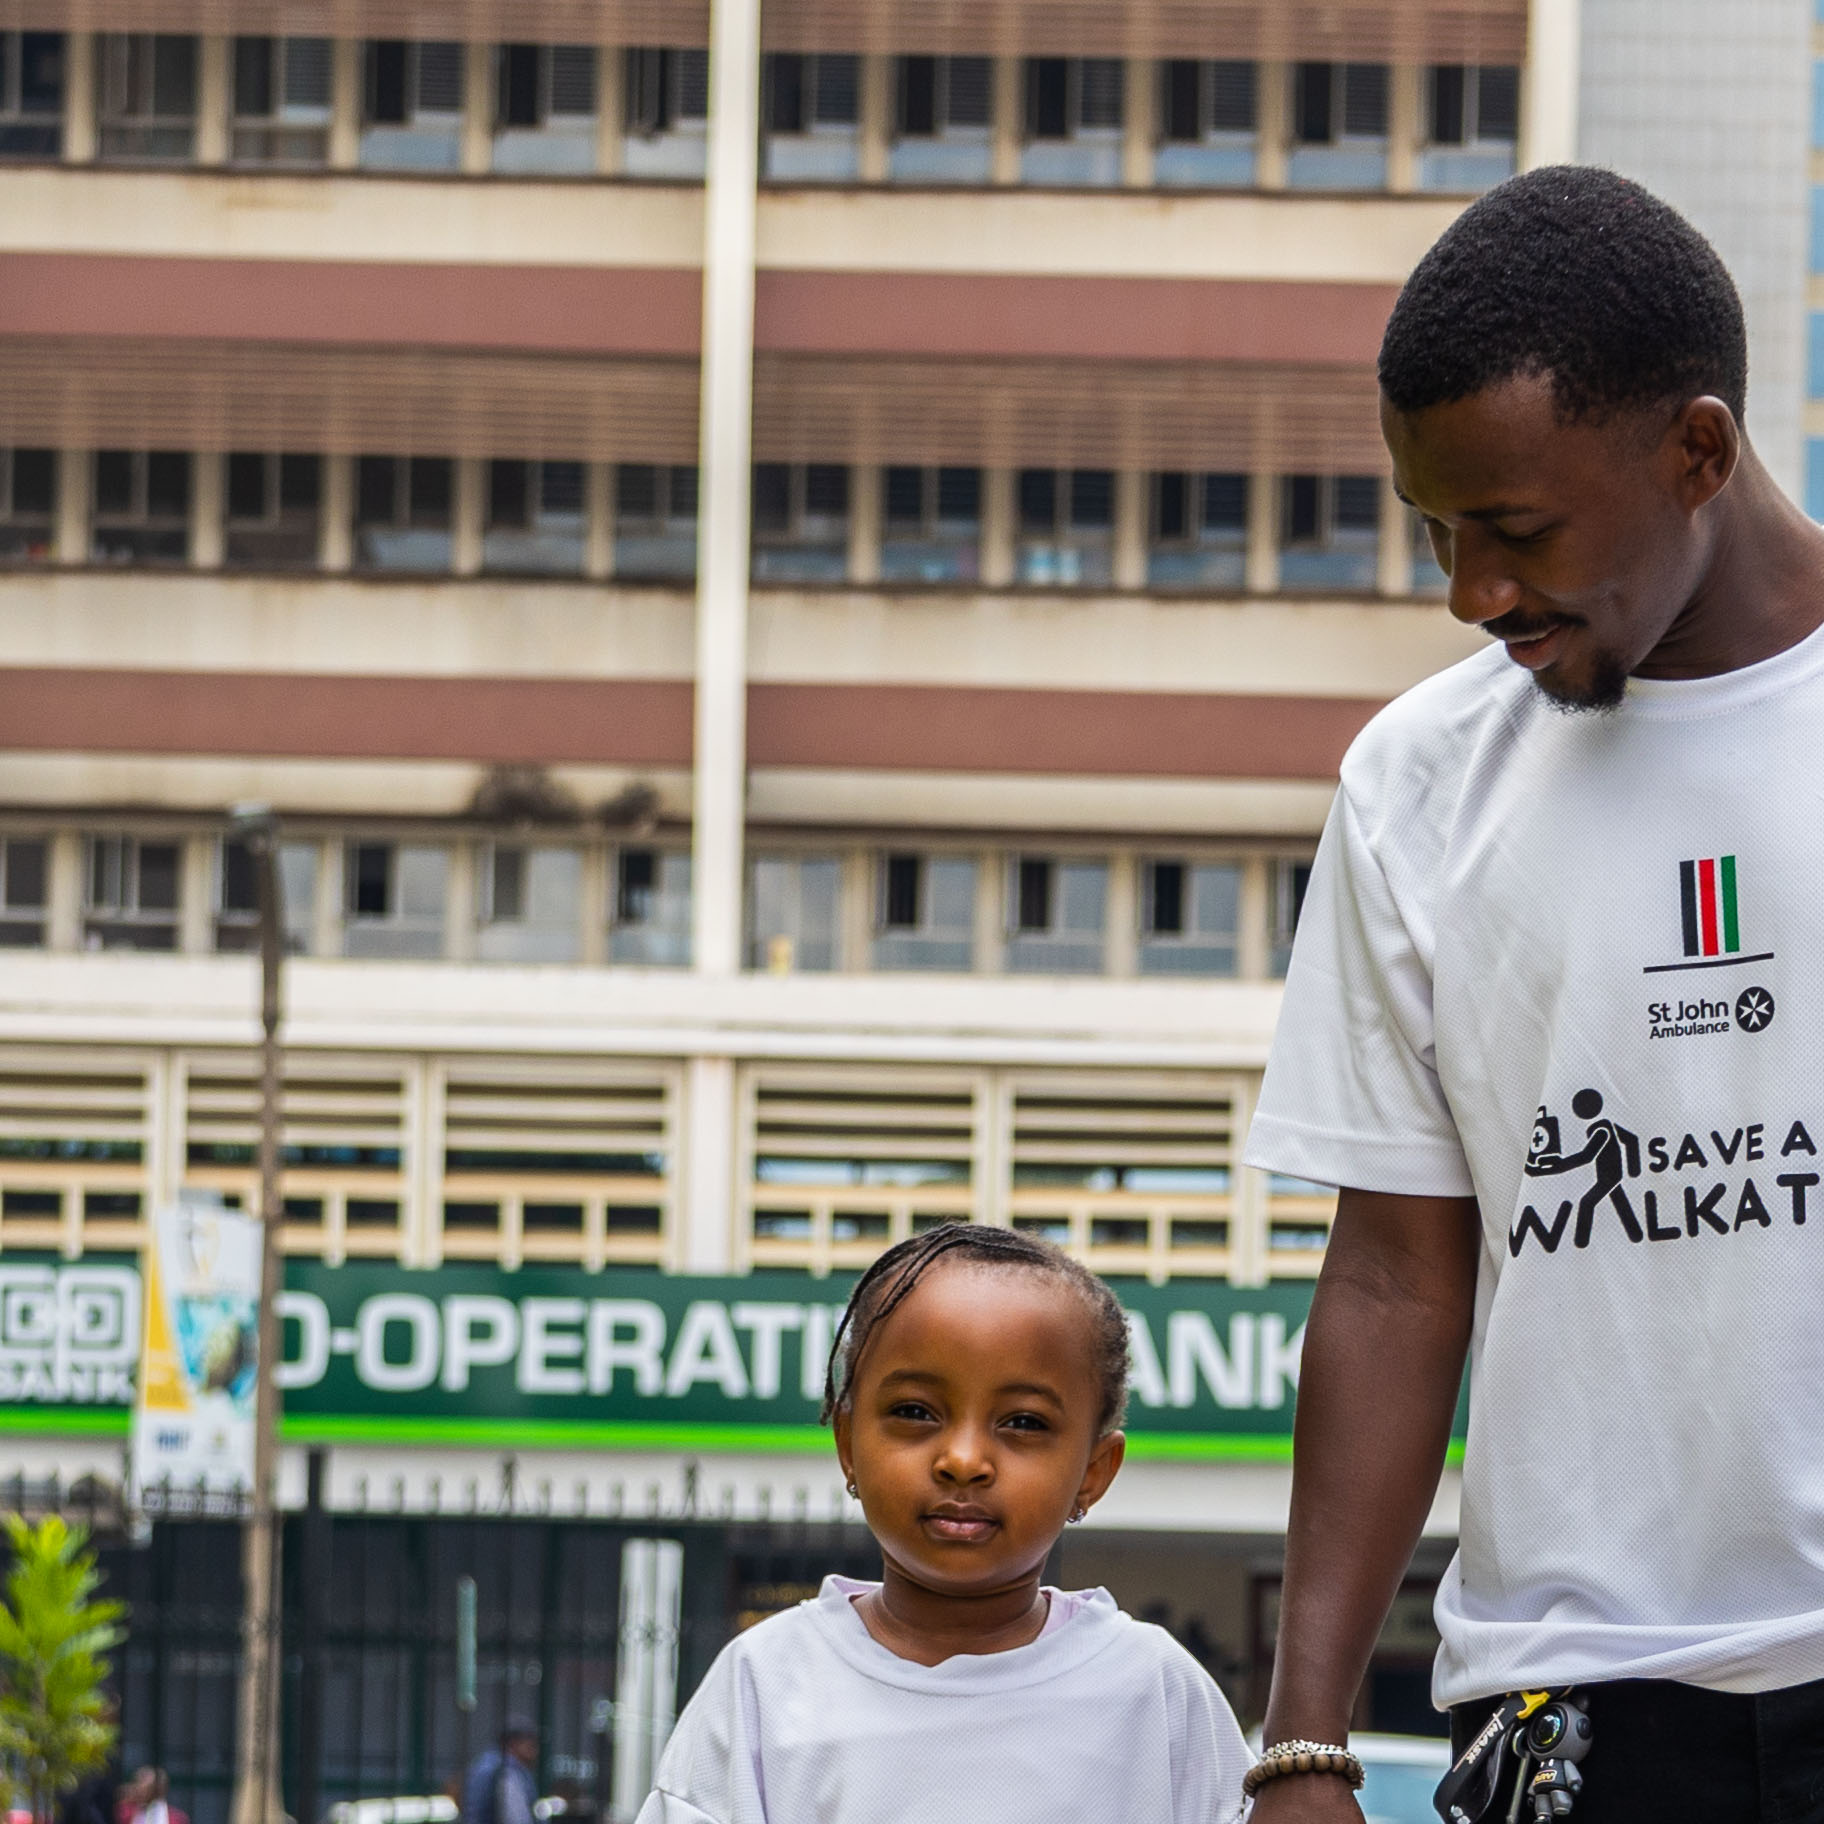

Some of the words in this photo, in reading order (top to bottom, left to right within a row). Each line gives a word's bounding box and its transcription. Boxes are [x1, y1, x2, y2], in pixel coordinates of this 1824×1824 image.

[1647, 1002, 1672, 1024] St
[1675, 998, 1730, 1022] John
[1649, 1021, 1731, 1040] Ambulance
[1647, 1122, 1766, 1174] SAVE
[1780, 1119, 1818, 1158] A
[1125, 1308, 1307, 1410] ANK
